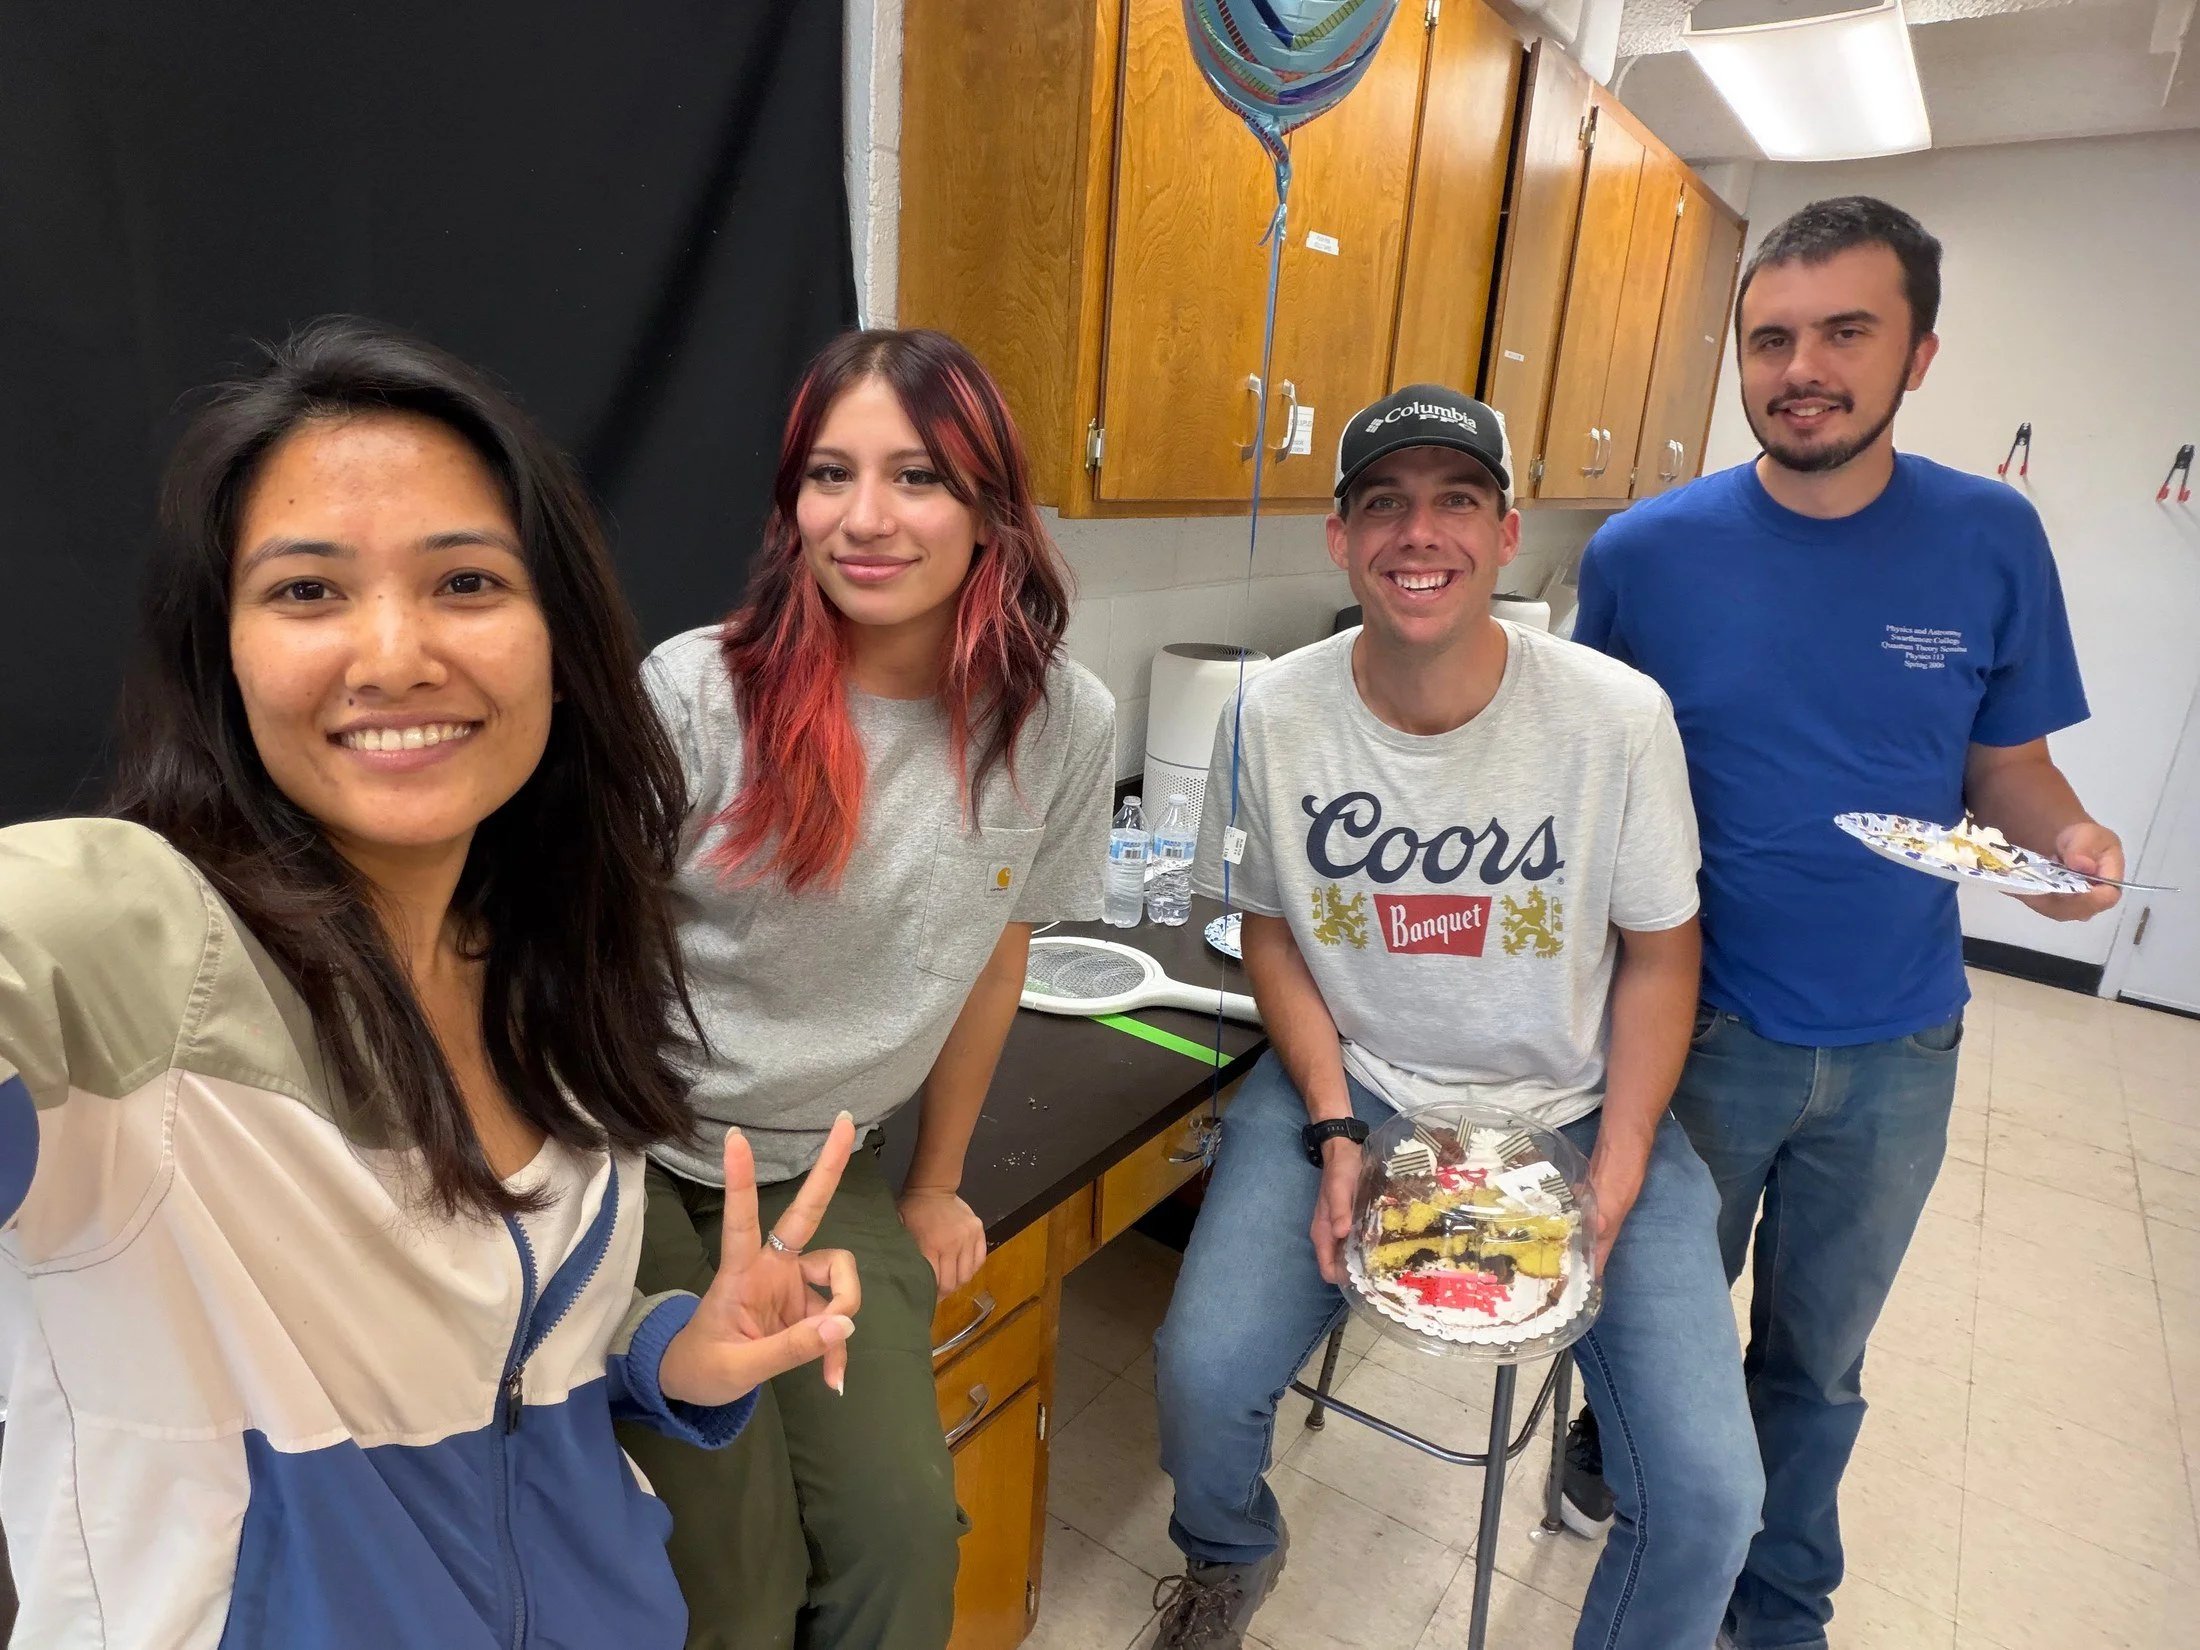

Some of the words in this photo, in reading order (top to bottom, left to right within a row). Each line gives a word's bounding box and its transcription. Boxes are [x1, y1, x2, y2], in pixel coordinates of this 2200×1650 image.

[1384, 401, 1477, 429] Columbia
[1885, 624, 1913, 634] Physics
[1915, 644, 1939, 653] Theory
[1905, 651, 1931, 661] Physics
[1904, 660, 1928, 669] Spring
[1301, 791, 1566, 885] Coors
[1388, 903, 1483, 948] Banquet
